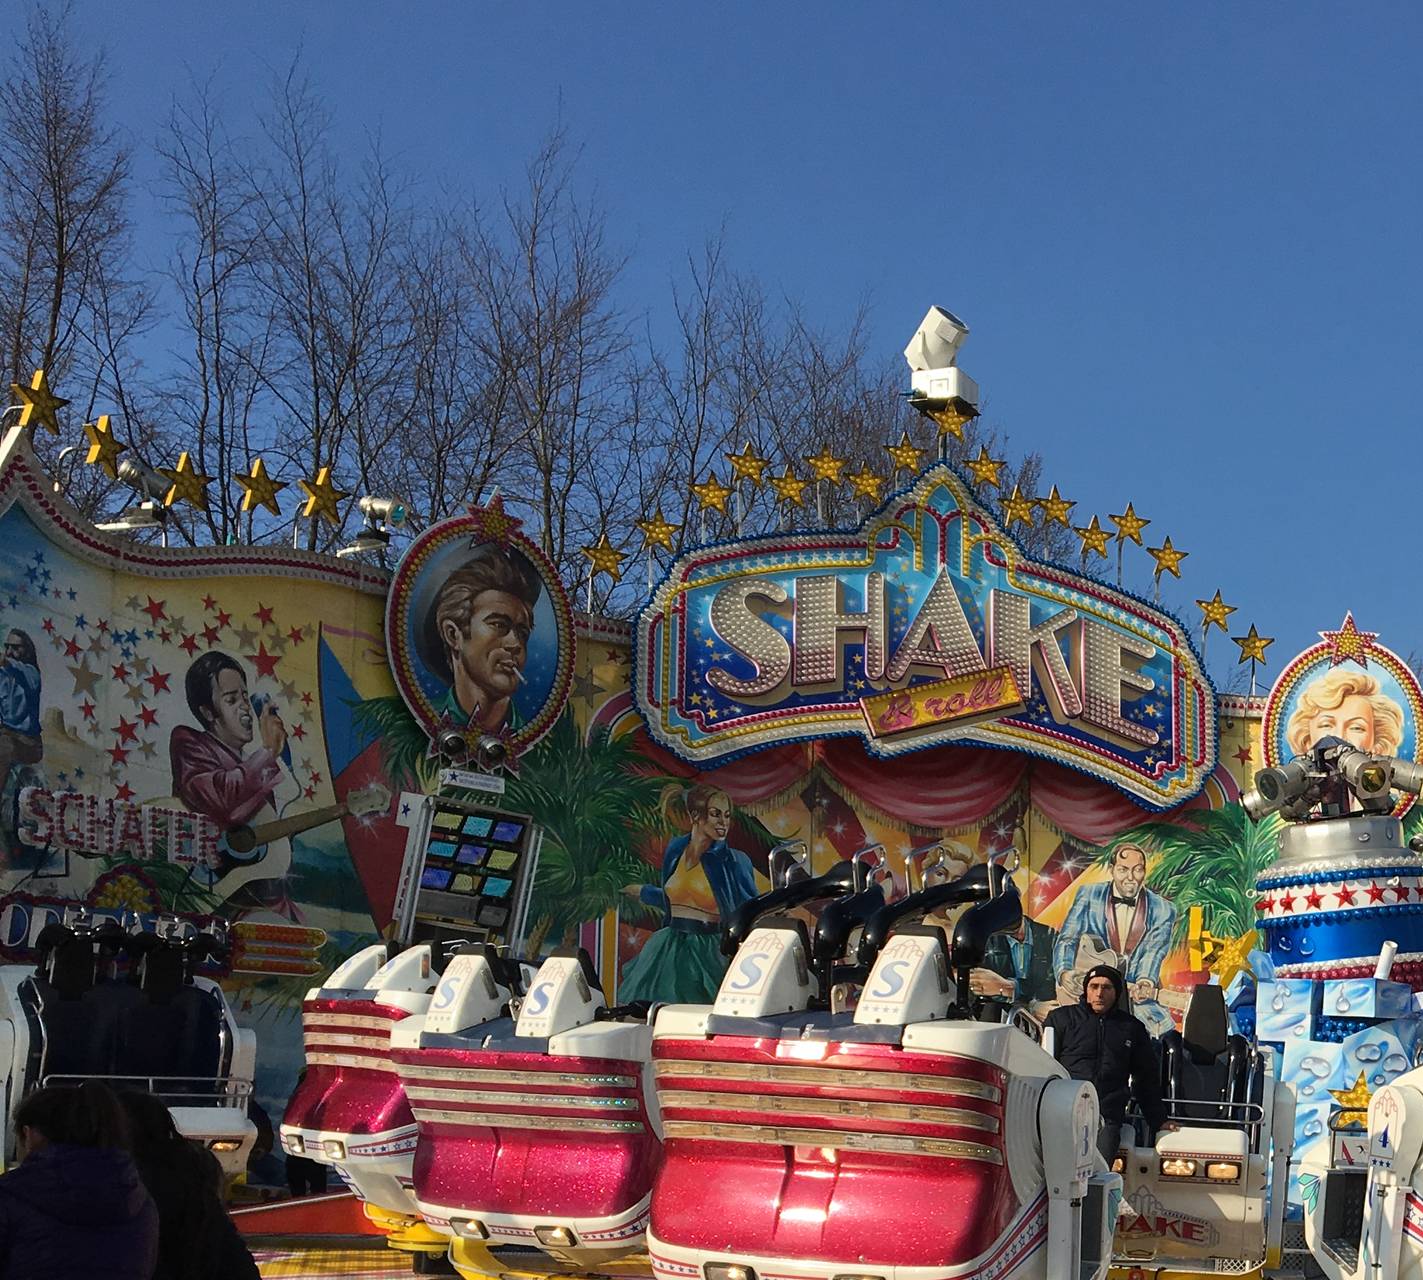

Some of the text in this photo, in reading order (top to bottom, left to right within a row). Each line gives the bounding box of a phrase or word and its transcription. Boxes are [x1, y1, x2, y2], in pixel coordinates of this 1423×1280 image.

[704, 564, 1160, 746] SHAKE
[924, 673, 1004, 719] roll
[731, 953, 769, 990] S
[871, 960, 909, 997] S
[433, 976, 461, 1009] S
[527, 982, 555, 1015] S
[1378, 1123, 1389, 1149] 4
[1115, 1213, 1205, 1242] HAKE
